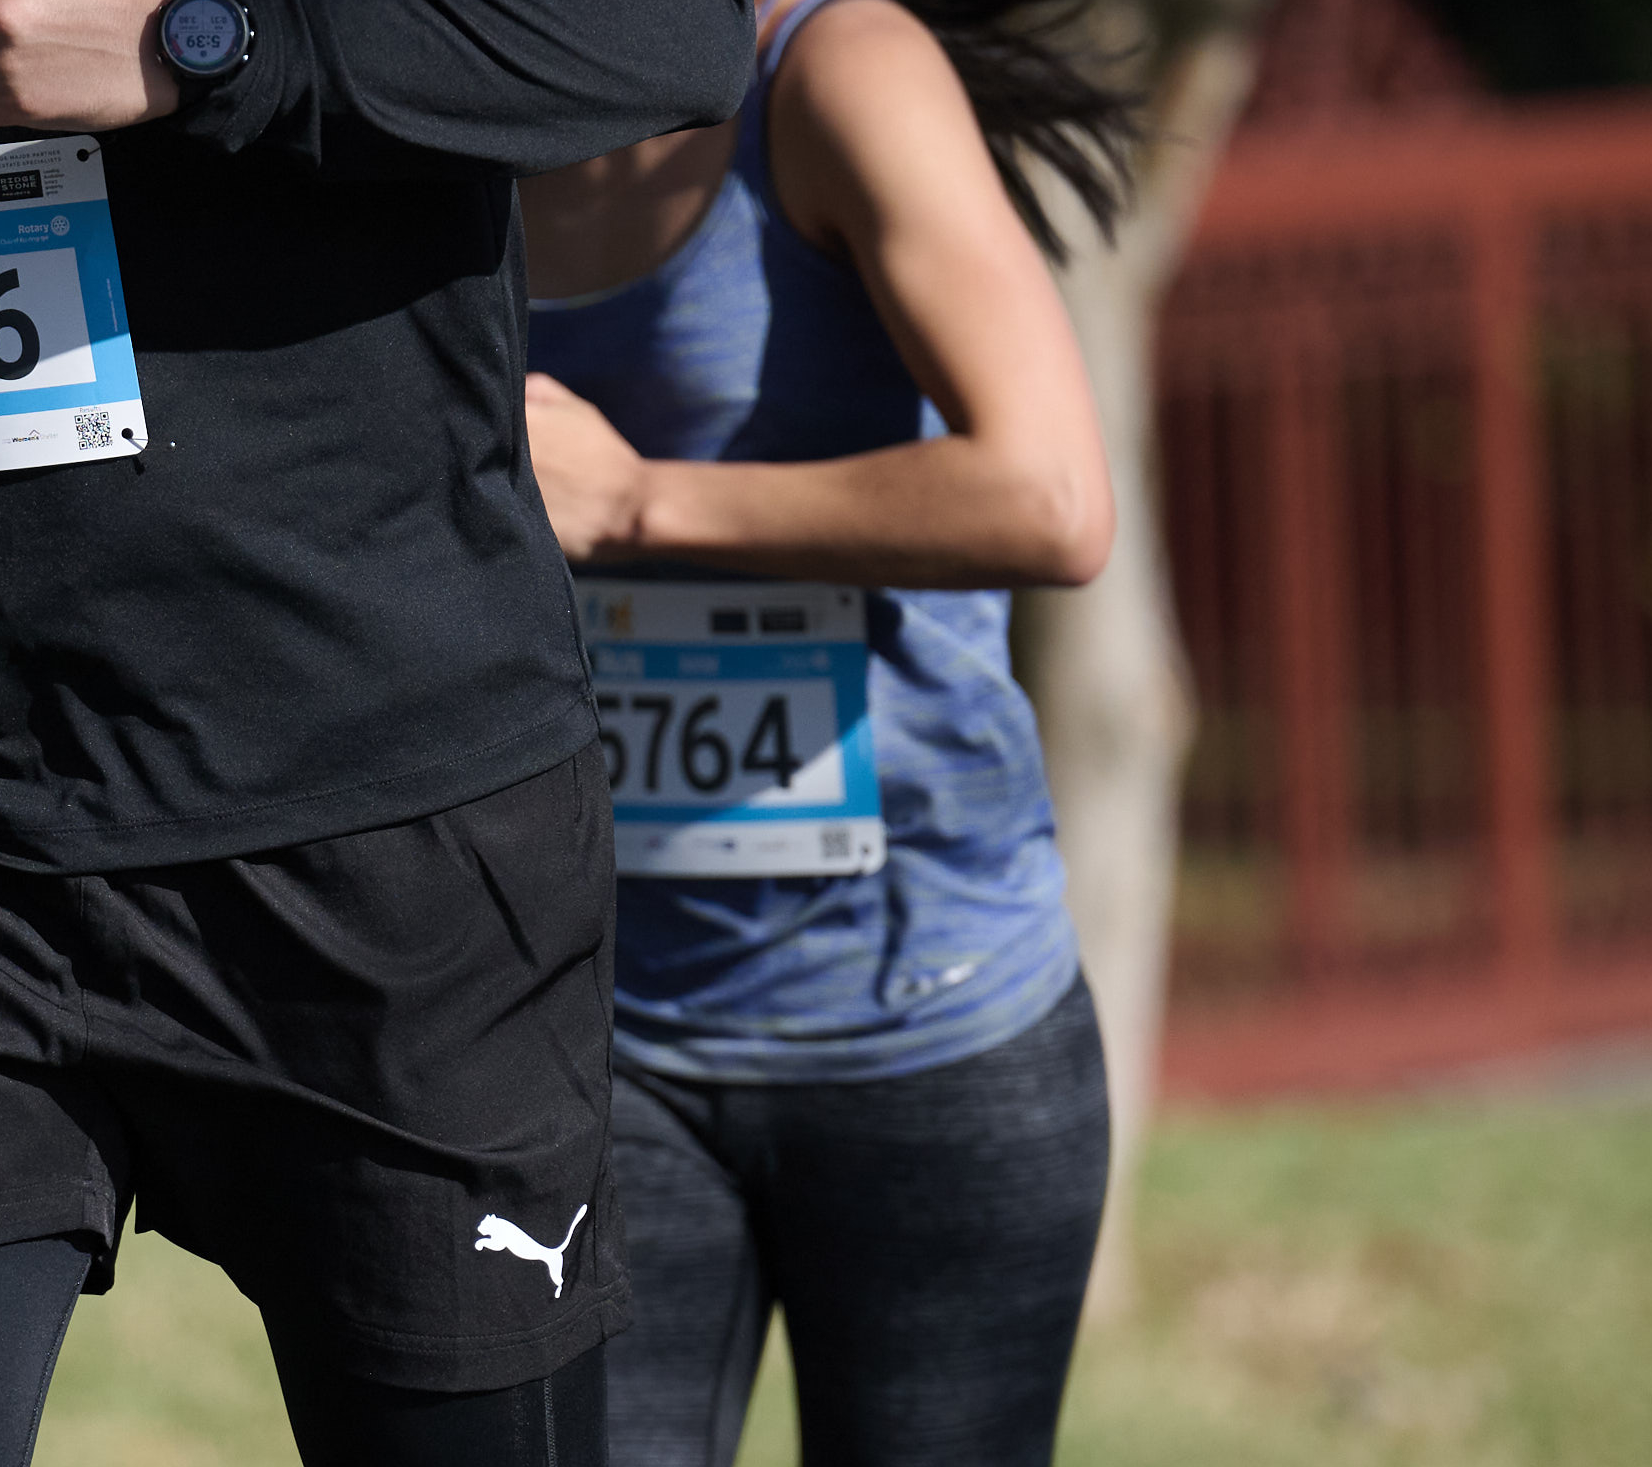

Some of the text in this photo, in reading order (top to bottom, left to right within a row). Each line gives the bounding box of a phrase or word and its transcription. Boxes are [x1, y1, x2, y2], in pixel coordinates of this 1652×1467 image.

[186, 35, 220, 48] 5:39
[32, 150, 61, 158] PARTNER
[22, 157, 62, 166] SPECIALISTS
[1, 181, 37, 191] STONE
[18, 224, 49, 235] Rotary
[596, 693, 802, 793] 5764
